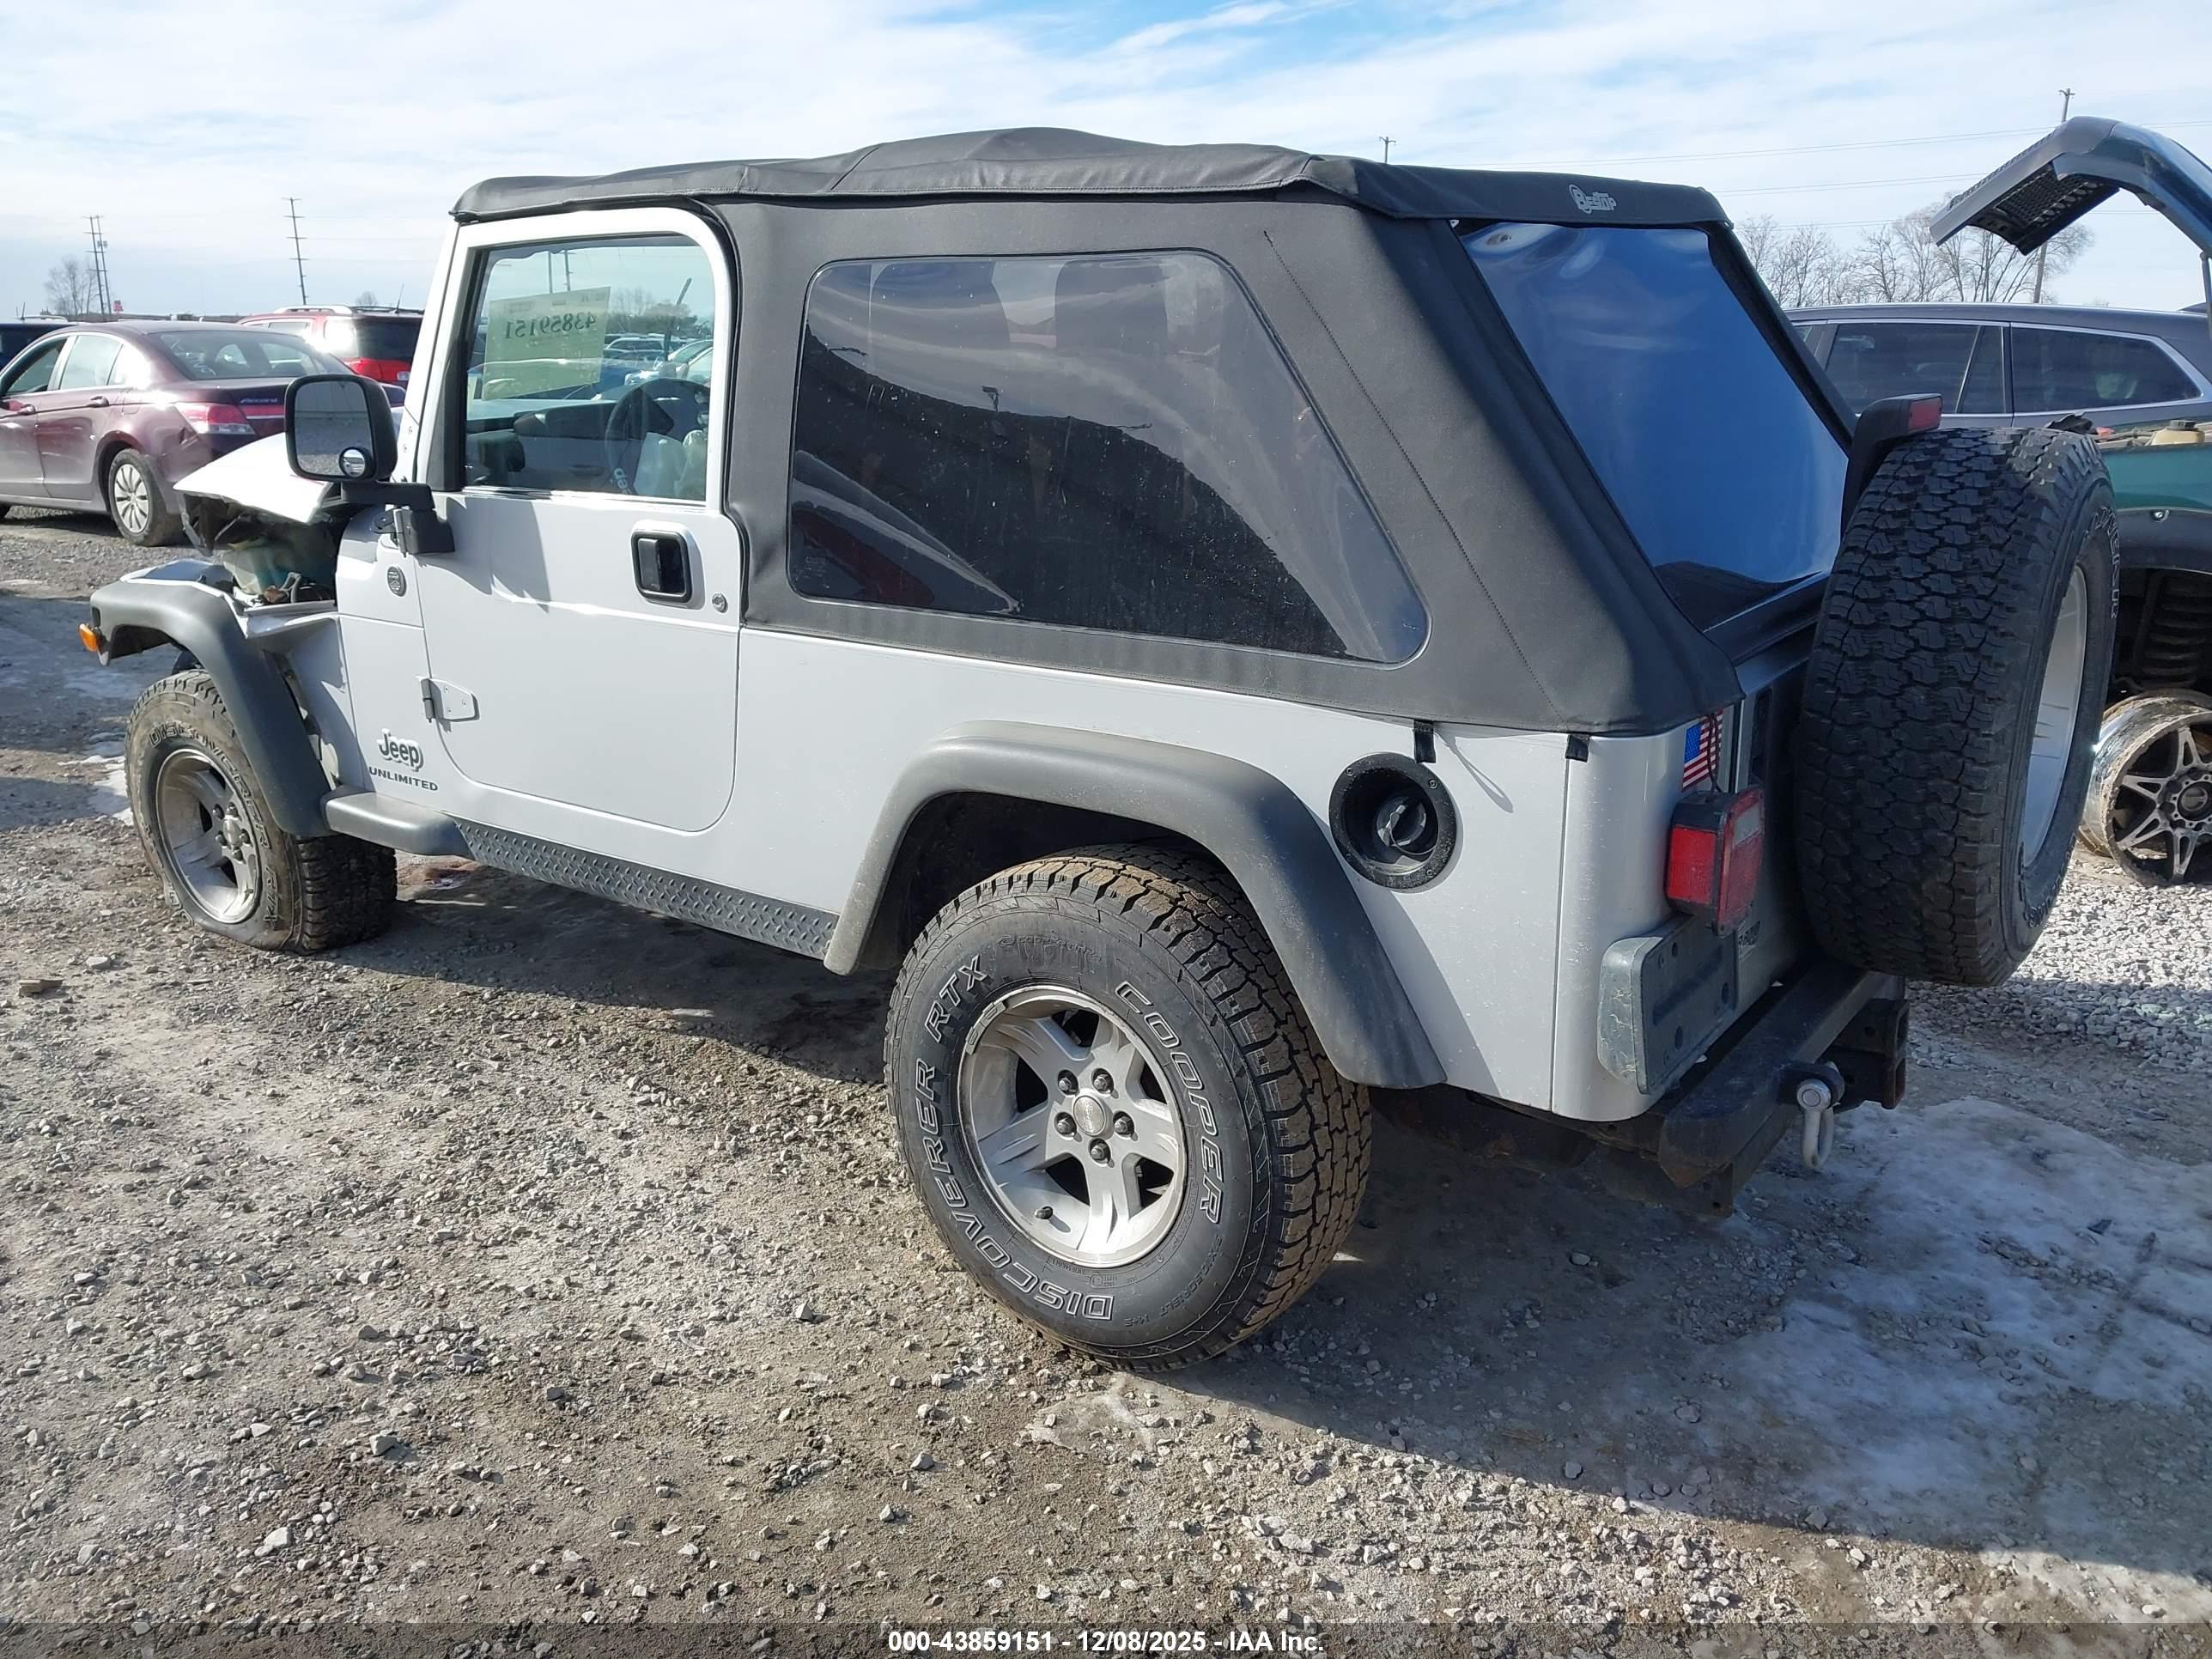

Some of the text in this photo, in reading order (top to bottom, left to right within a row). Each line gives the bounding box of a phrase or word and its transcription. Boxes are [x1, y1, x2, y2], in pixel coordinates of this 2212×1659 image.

[368, 766, 439, 791] UNLIMITED
[378, 730, 423, 770] Jeep
[925, 954, 988, 1043] RTX
[1115, 981, 1224, 1224] COOPER
[915, 1057, 1115, 1322] DISCOVERER
